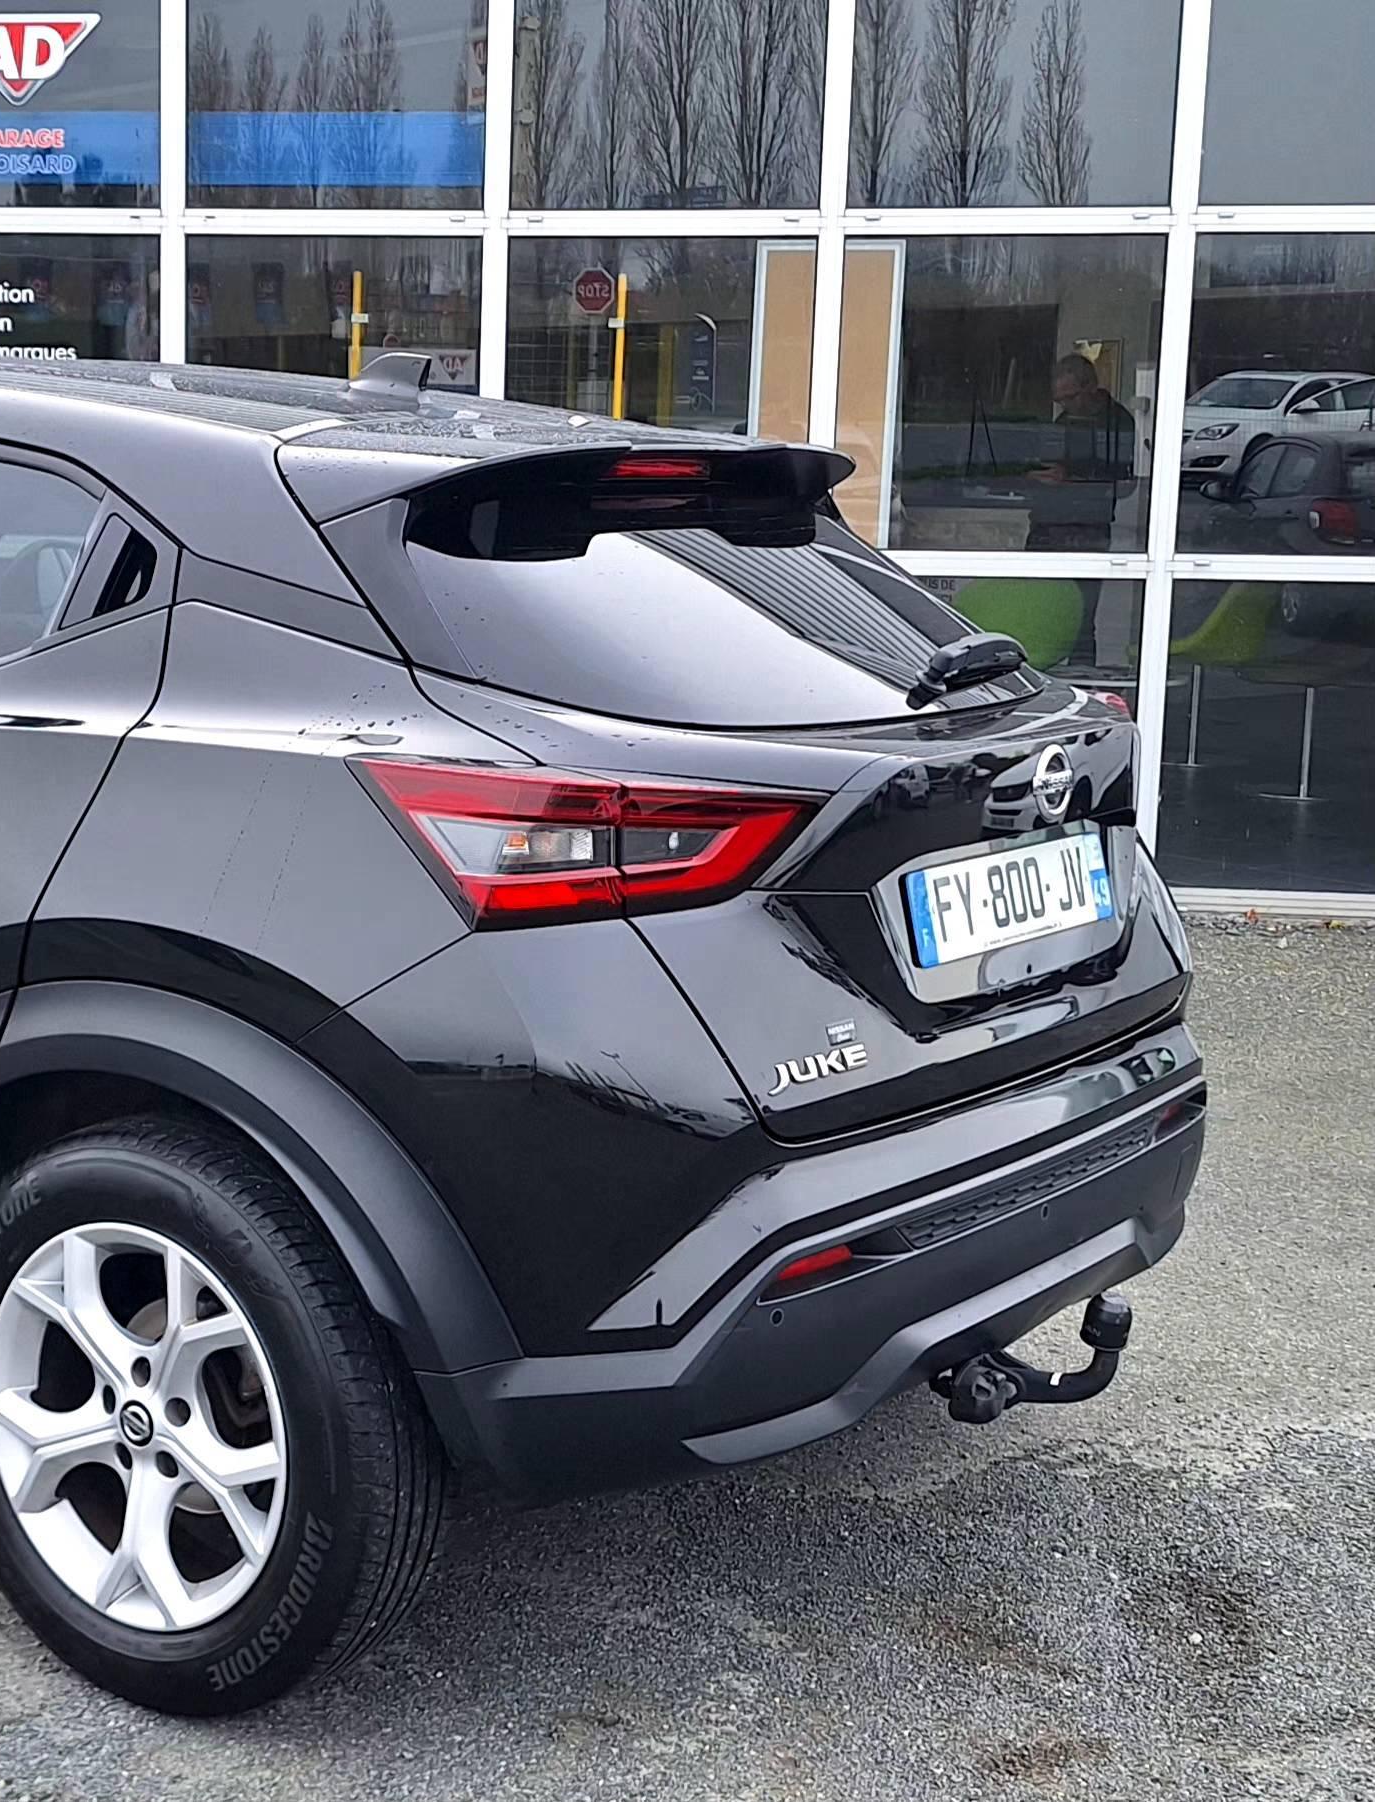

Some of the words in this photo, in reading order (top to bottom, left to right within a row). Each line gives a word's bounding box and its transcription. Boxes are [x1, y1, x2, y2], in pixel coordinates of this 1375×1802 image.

[1093, 876, 1111, 909] 49
[768, 1042, 869, 1096] JUKE
[205, 1511, 333, 1692] BRIDGESTONE
